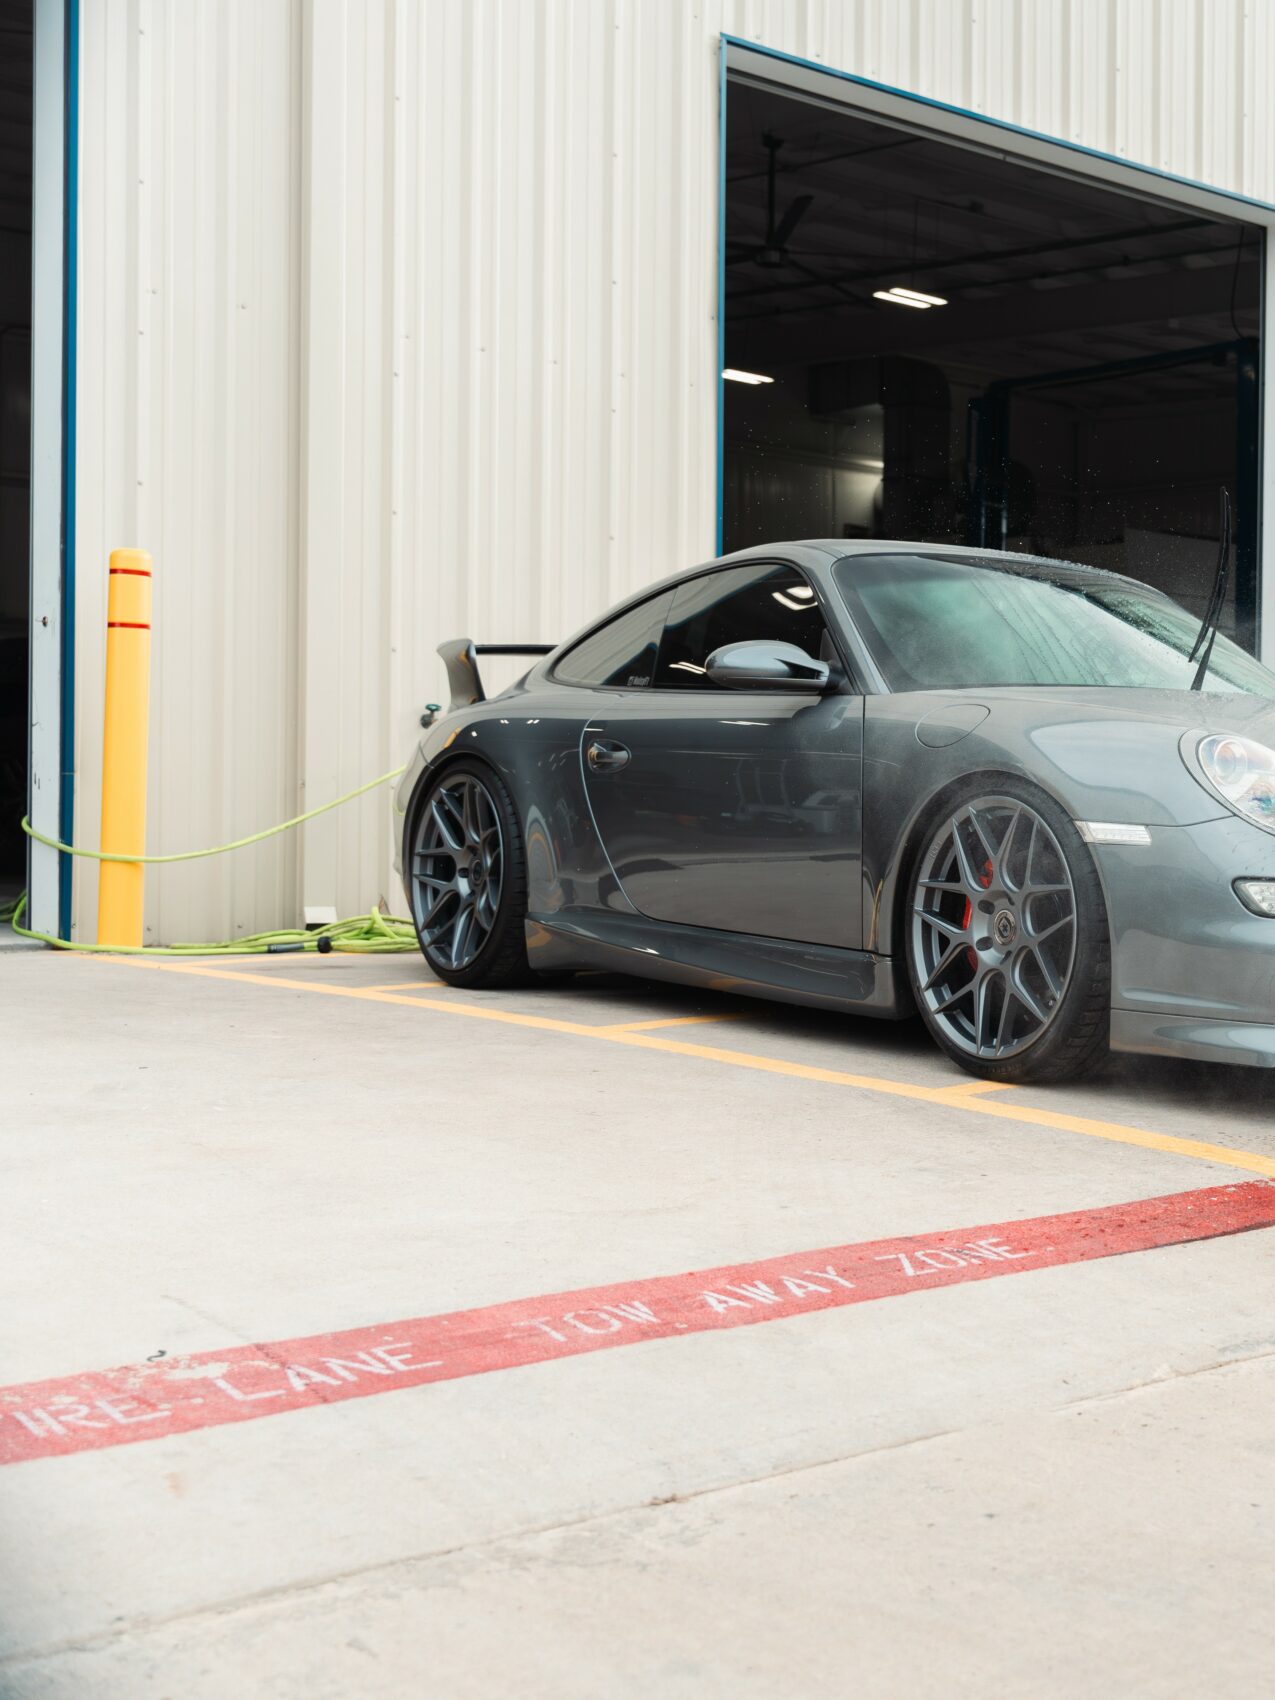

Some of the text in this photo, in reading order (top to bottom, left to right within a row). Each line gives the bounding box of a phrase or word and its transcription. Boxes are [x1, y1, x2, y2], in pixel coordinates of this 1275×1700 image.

[0, 1236, 1037, 1437] IRE LANE TOW AWAY ZONE
